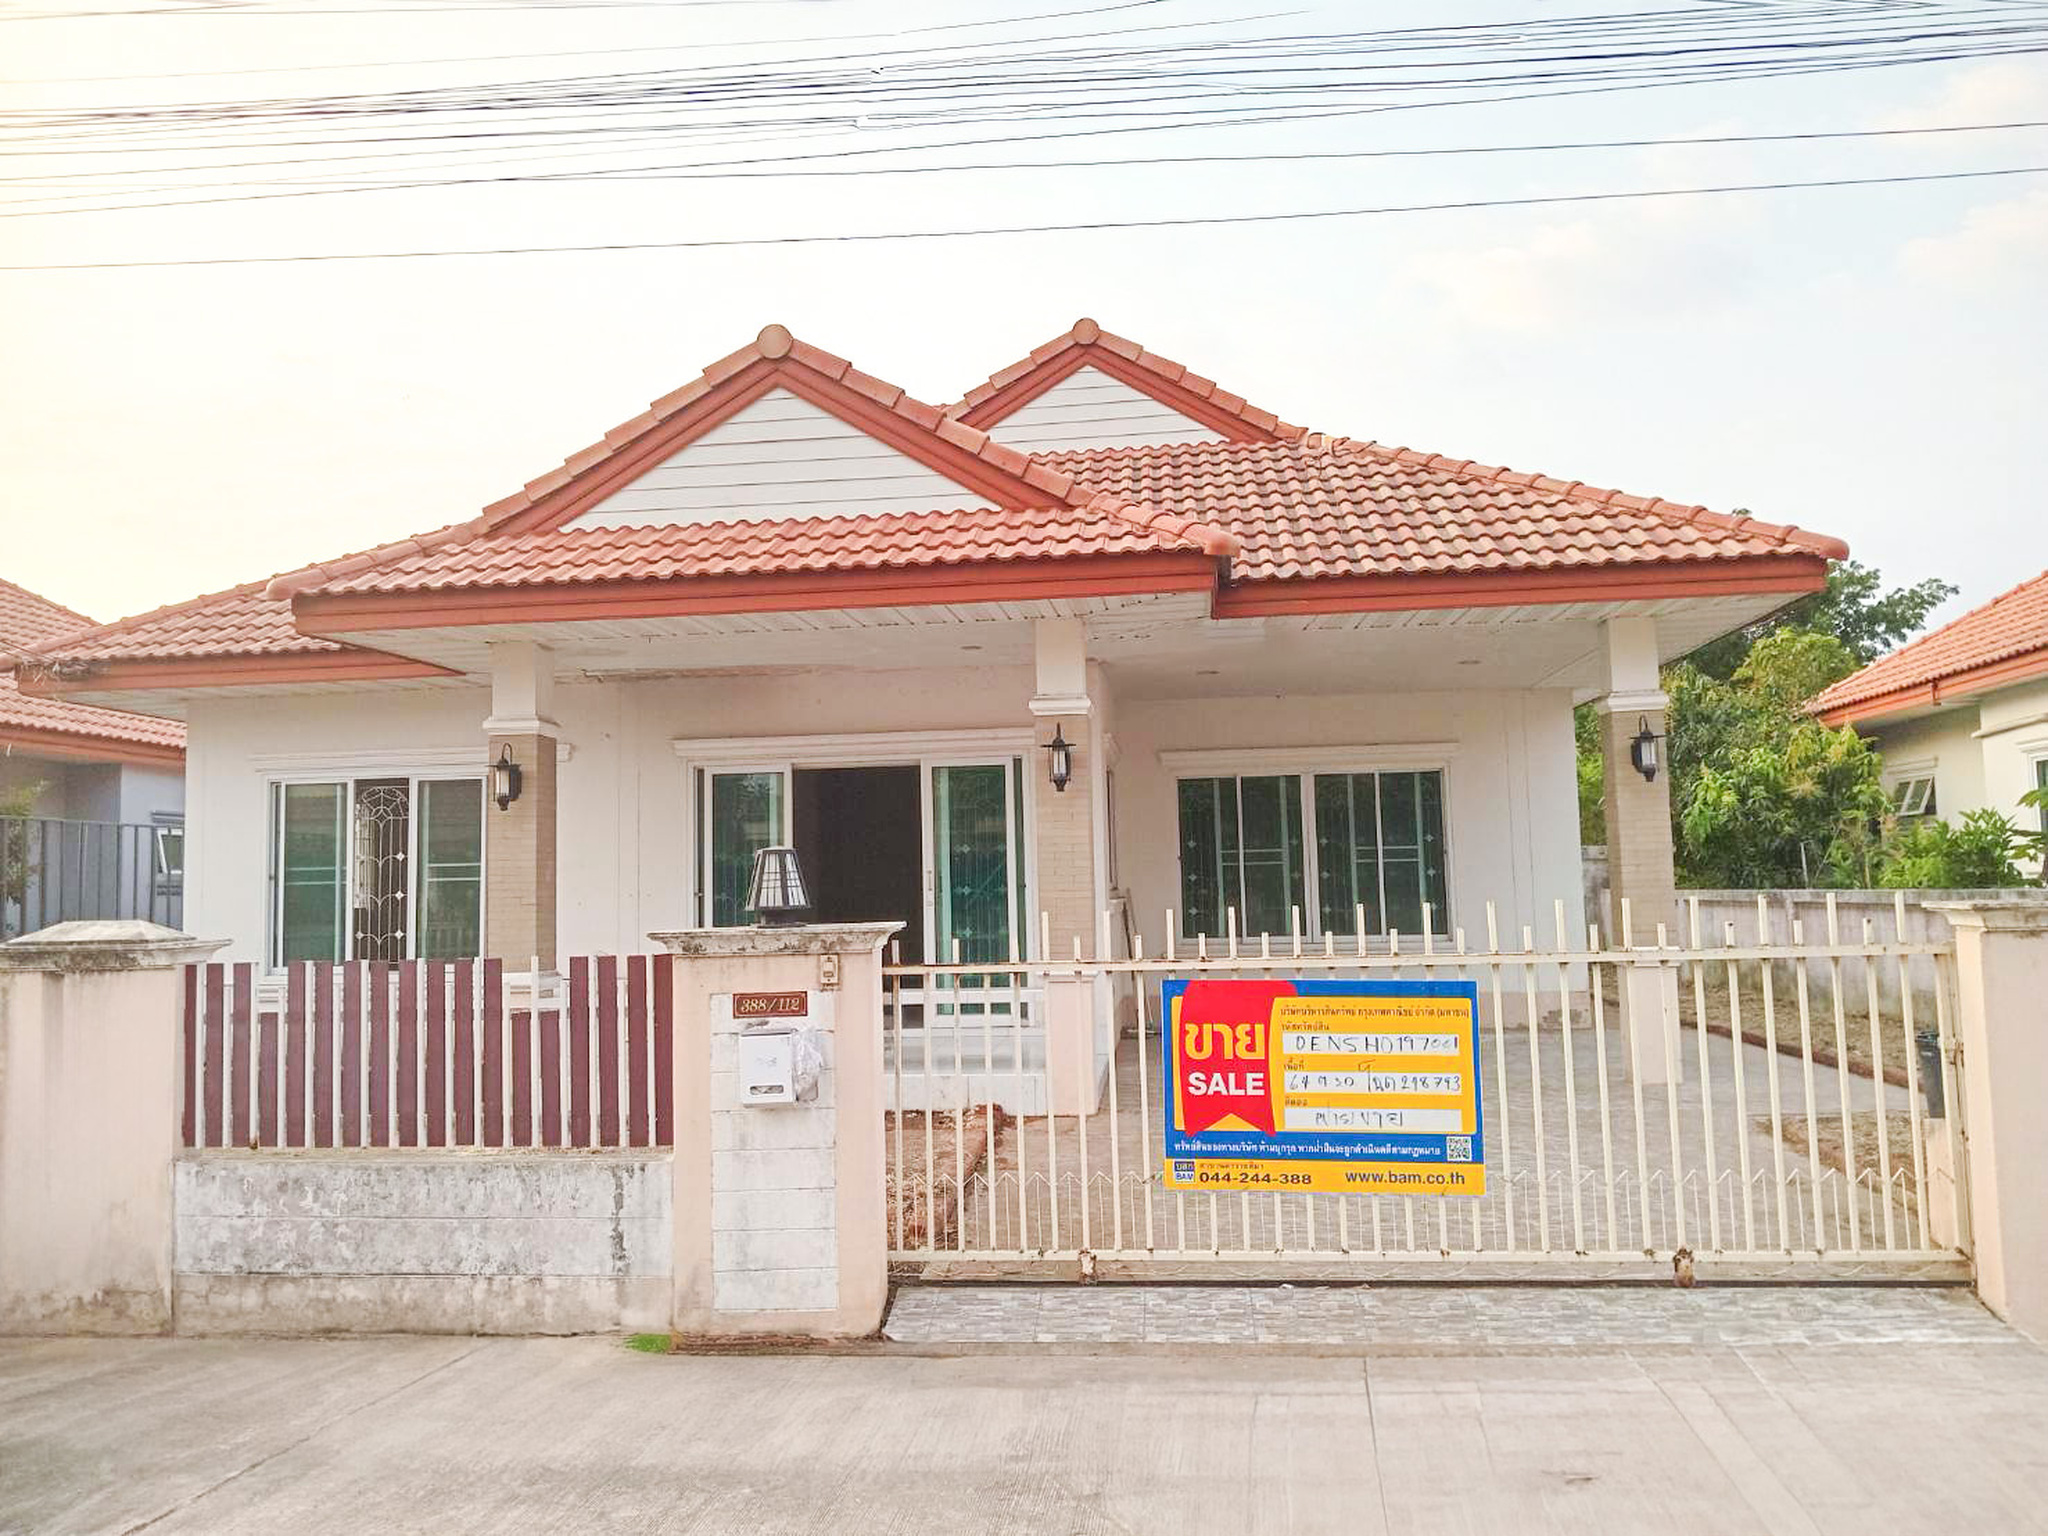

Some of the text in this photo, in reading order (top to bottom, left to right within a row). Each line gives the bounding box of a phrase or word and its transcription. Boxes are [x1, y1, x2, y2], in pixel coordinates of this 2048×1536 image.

[741, 997, 800, 1013] 388/112
[1184, 1022, 1266, 1060] ขาย
[1187, 1071, 1266, 1097] SALE
[1175, 1172, 1194, 1181] BAM
[1199, 1171, 1312, 1185] 044-244-388
[1345, 1170, 1466, 1185] www.bam.co.th
